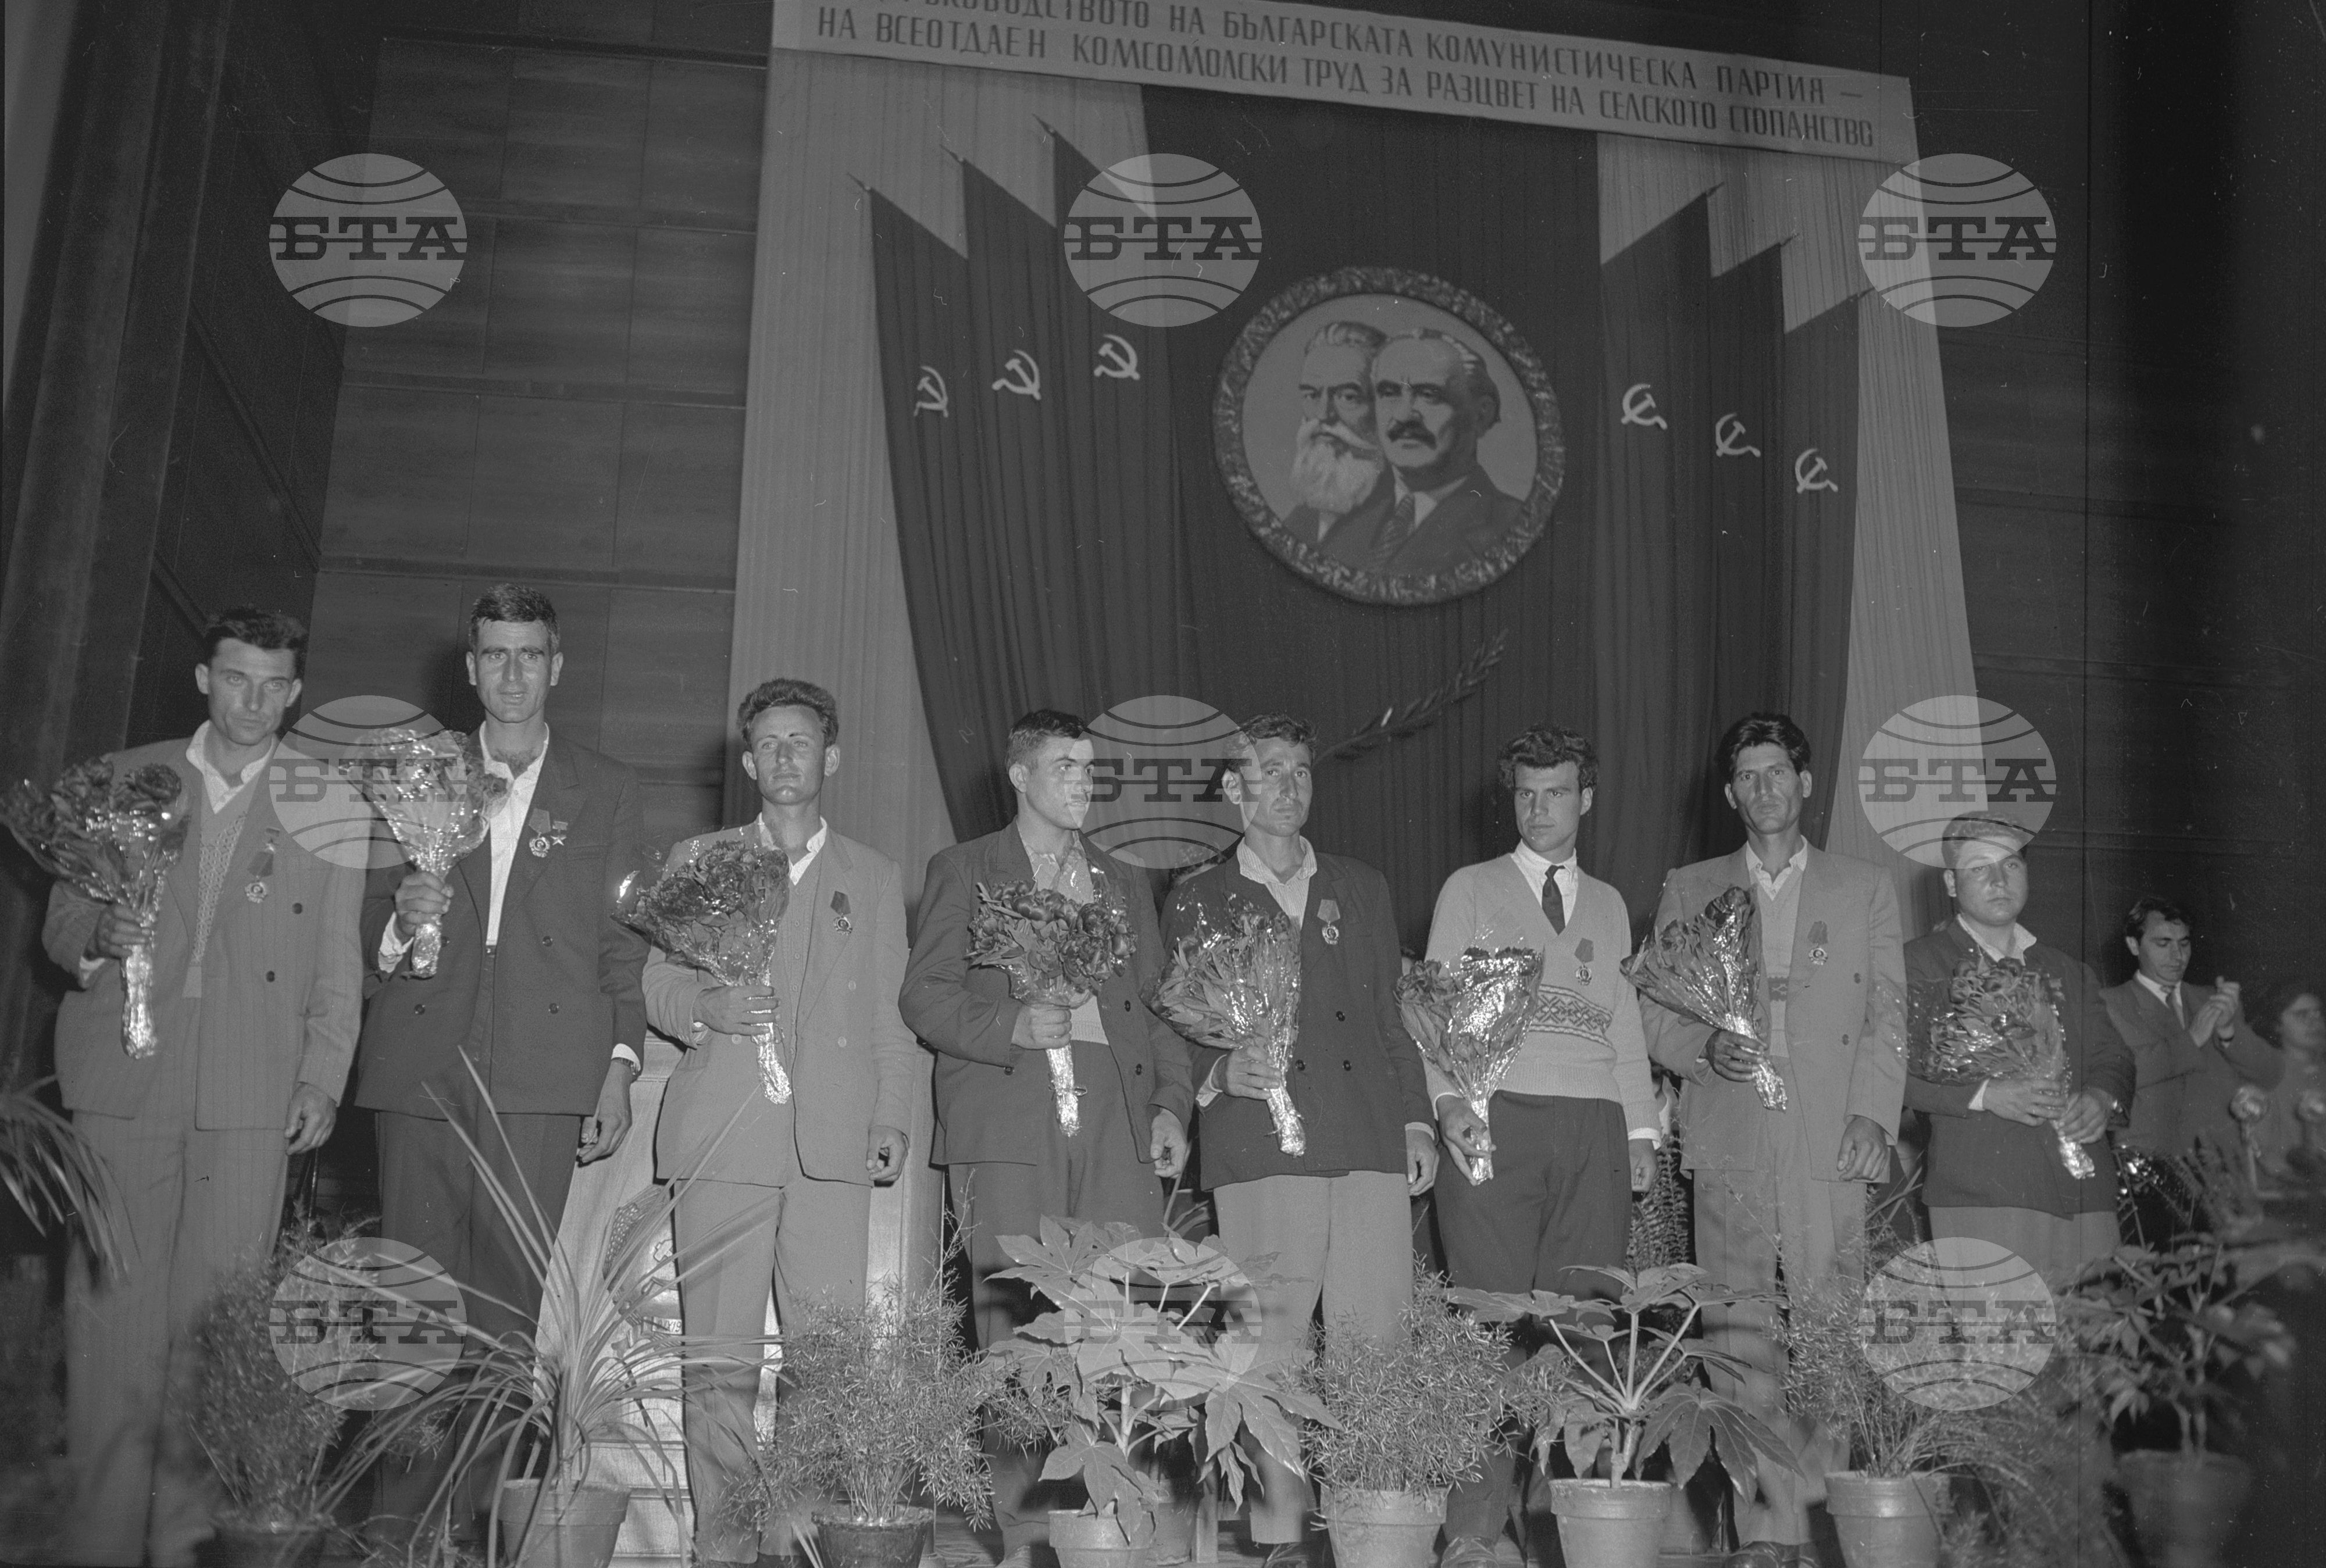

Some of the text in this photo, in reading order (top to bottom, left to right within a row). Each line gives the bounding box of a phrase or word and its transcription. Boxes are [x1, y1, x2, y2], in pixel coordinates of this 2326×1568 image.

[818, 7, 1874, 148] НА ВСЕОТДАЕН КОМСОМОЛСКИ ТРУД ЗА РАЗЦВЕТ НА СЕЛСКОТО СТОПАНСТВО
[904, 0, 1150, 28] ОДСТВОТО
[1169, 5, 1205, 35] НА
[1223, 12, 1412, 58] БЪЛГАРСКАТА
[1427, 33, 1697, 90] КОМУНИСТИЧЕСКА
[1717, 65, 1825, 104] ПАРТИЯ
